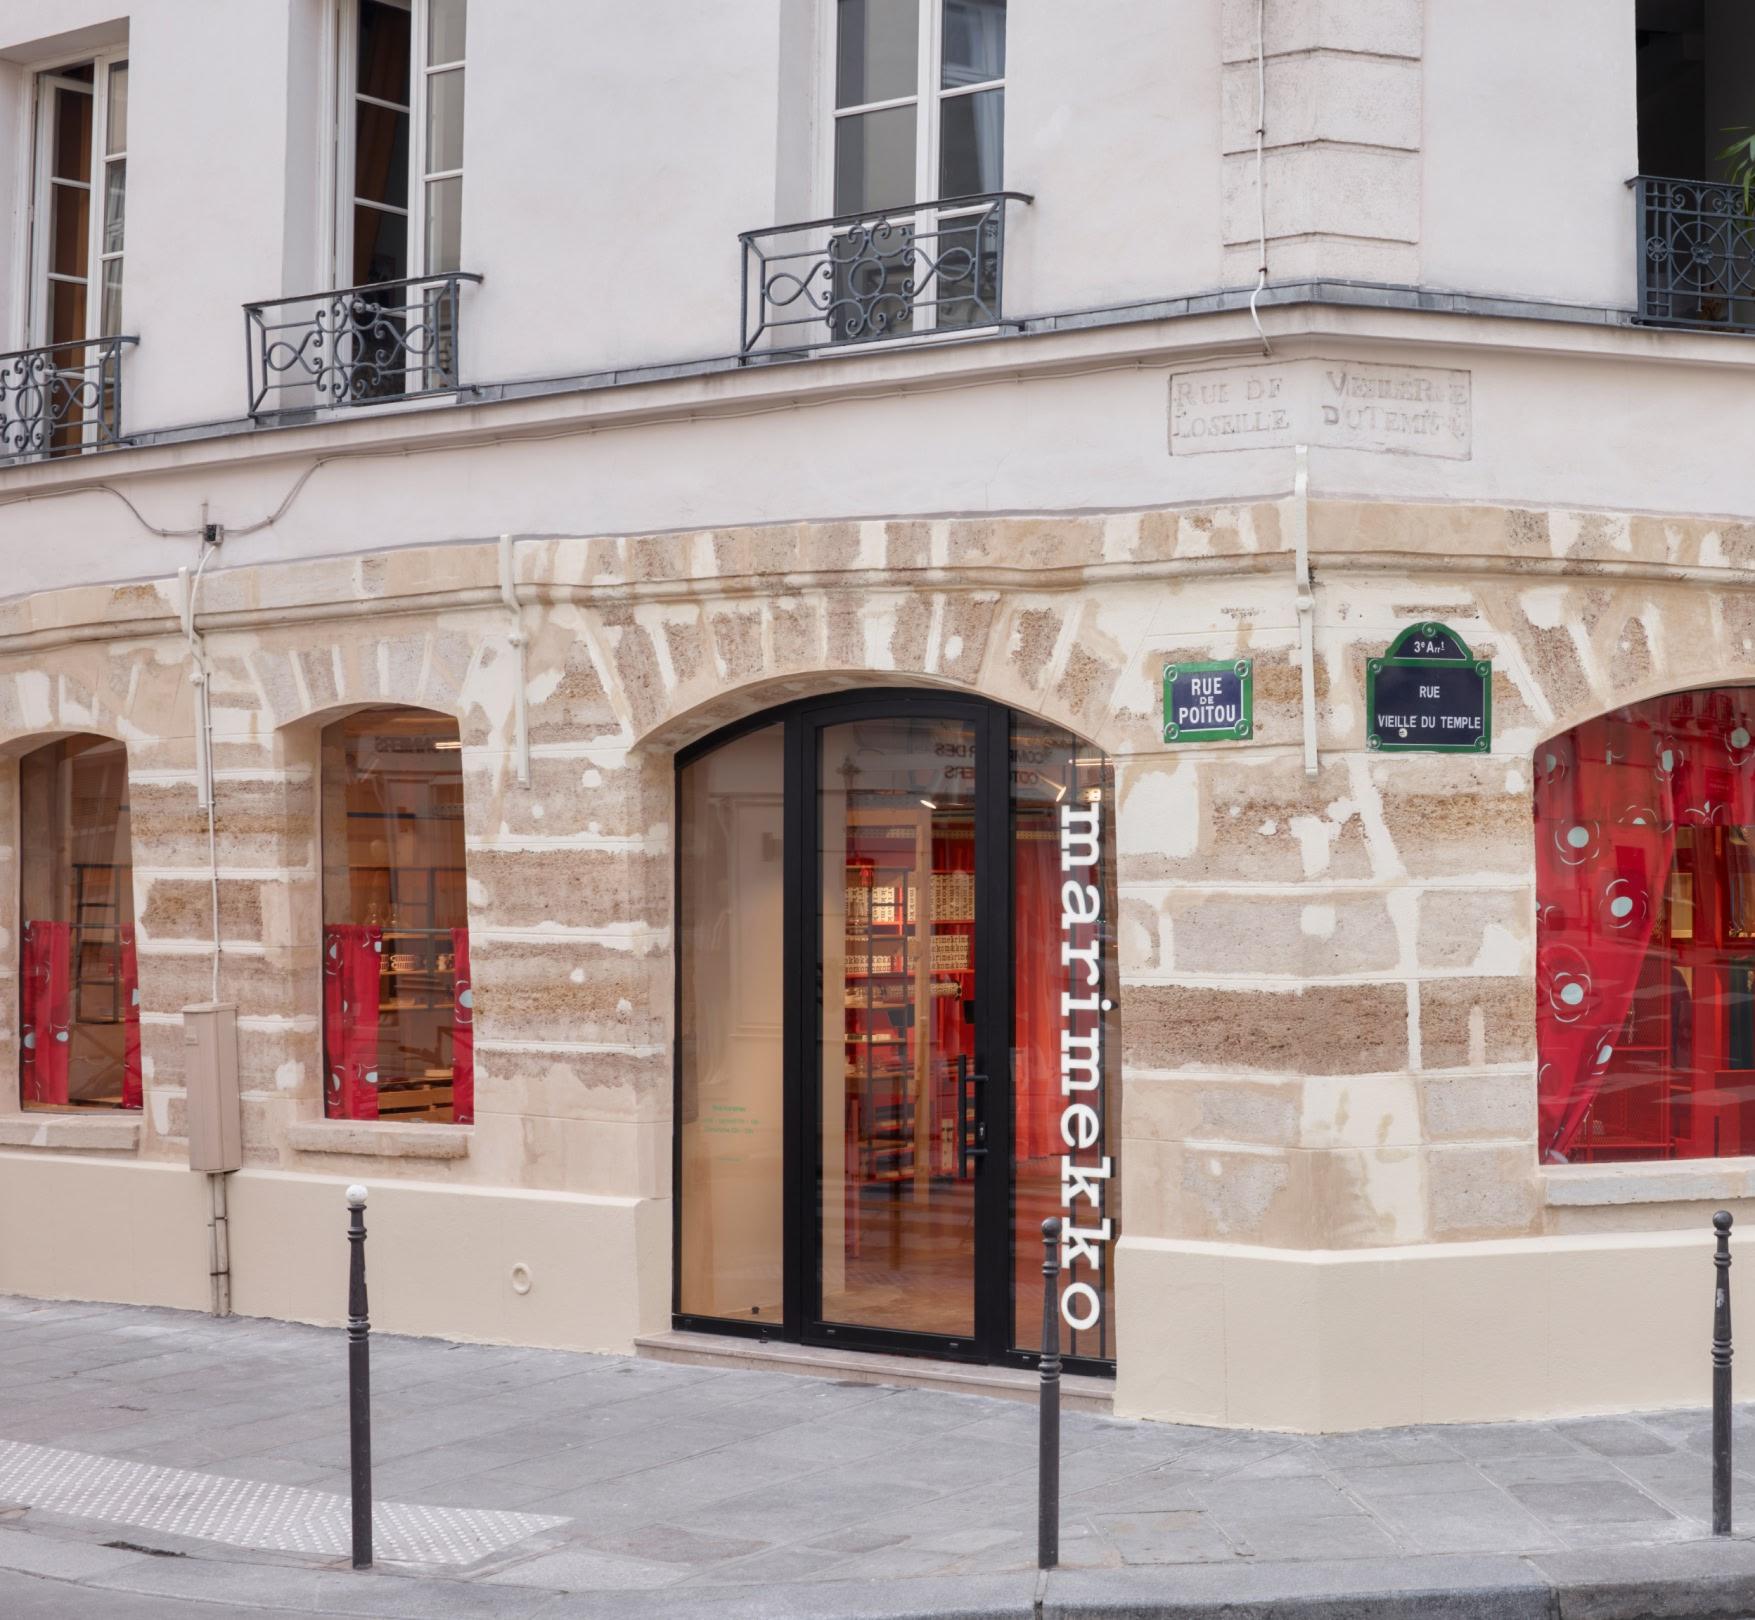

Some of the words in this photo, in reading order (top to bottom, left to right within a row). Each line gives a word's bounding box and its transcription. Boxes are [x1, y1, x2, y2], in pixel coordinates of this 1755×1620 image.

[1191, 677, 1223, 696] RUE
[1419, 685, 1441, 698] RUE
[1200, 696, 1214, 705] DE
[1179, 704, 1236, 724] POITOU
[1378, 714, 1417, 728] VIEILLE
[1421, 716, 1436, 728] DU
[1440, 716, 1481, 729] TEMPLE
[1061, 802, 1112, 1330] marimekko
